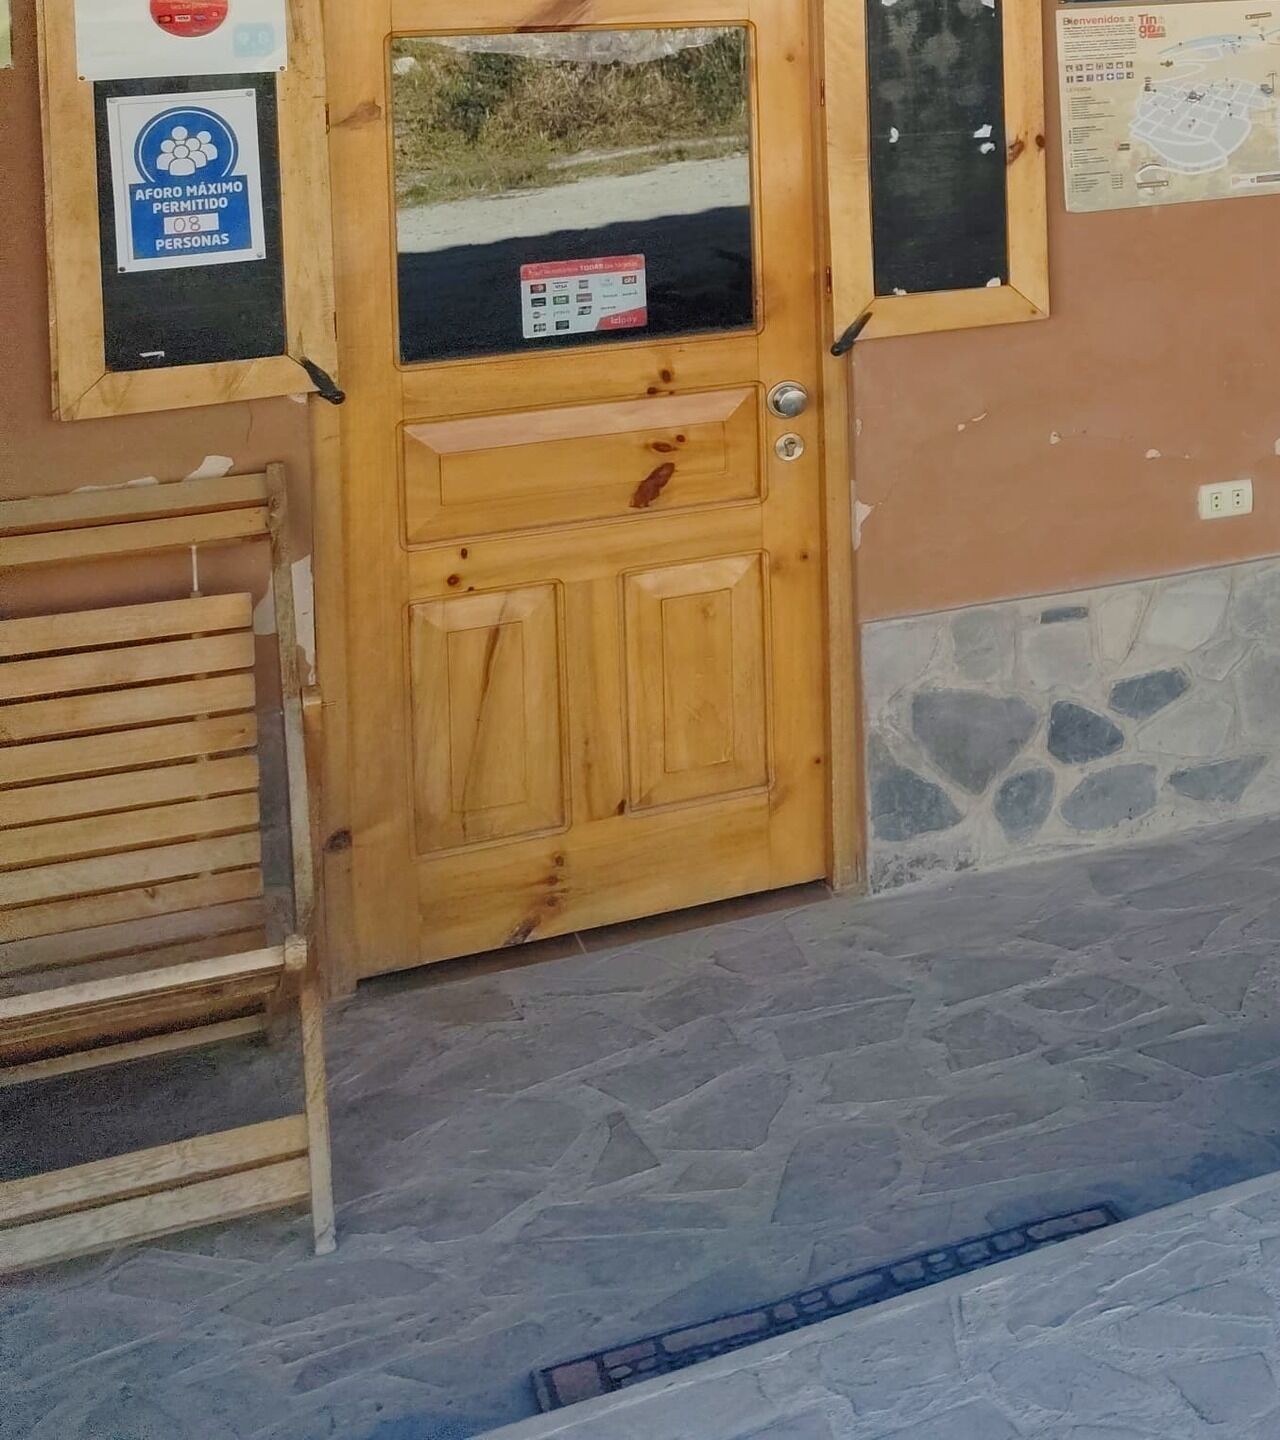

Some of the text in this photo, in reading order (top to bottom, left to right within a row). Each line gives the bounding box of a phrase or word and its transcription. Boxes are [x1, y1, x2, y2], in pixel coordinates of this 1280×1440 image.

[1063, 16, 1125, 26] Bienvenidos
[135, 181, 243, 201] AFORO MÁXIMO
[152, 197, 229, 214] PERMITIDO
[173, 216, 201, 233] 08
[155, 233, 230, 251] PERSONAS
